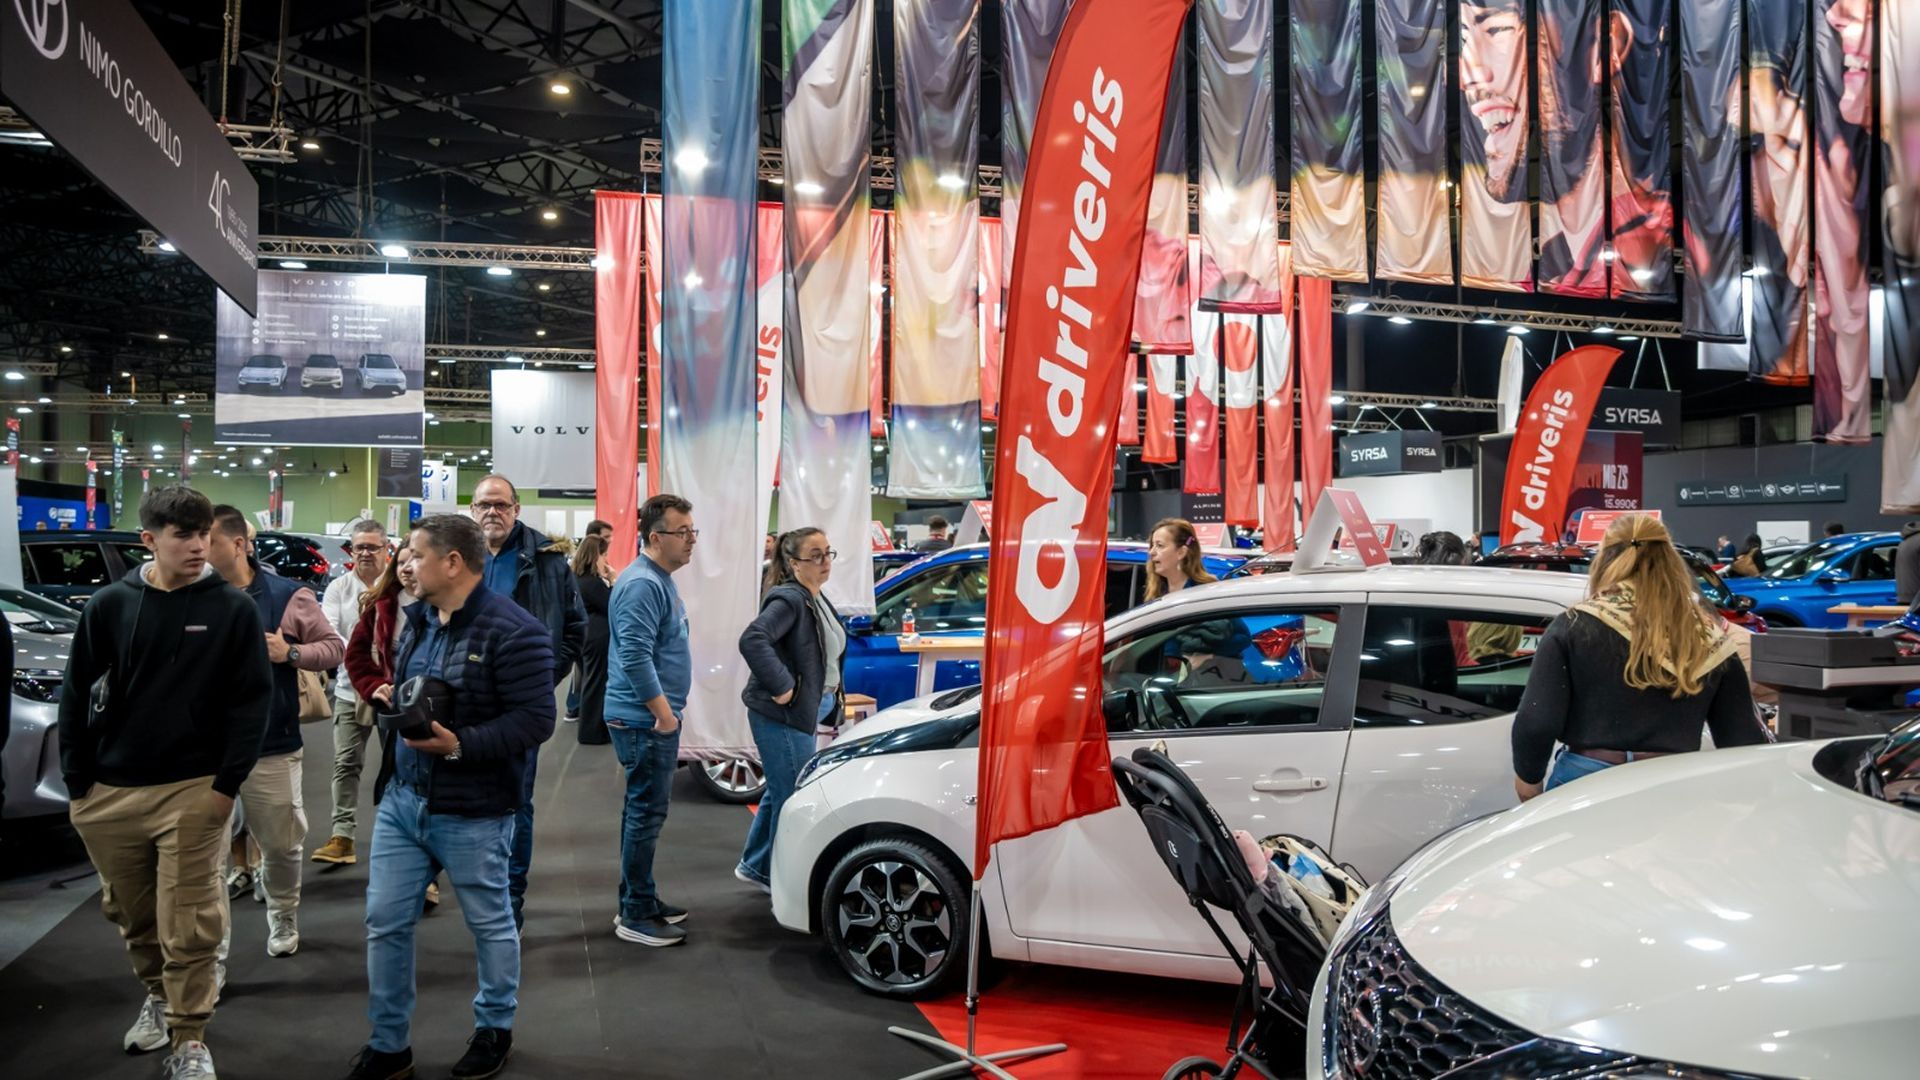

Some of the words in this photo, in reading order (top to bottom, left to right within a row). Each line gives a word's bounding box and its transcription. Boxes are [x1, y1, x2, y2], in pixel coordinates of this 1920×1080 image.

[79, 21, 121, 99] NIMO
[123, 77, 182, 168] GORDILLO
[1037, 66, 1124, 437] driveris
[292, 278, 357, 287] VOLVO
[1604, 406, 1662, 426] SYRSA
[511, 425, 590, 436] VOLV
[1350, 446, 1389, 463] SYRSA
[1406, 446, 1437, 458] SYRSA
[1520, 388, 1574, 511] driveris
[1604, 499, 1638, 509] 15.990€
